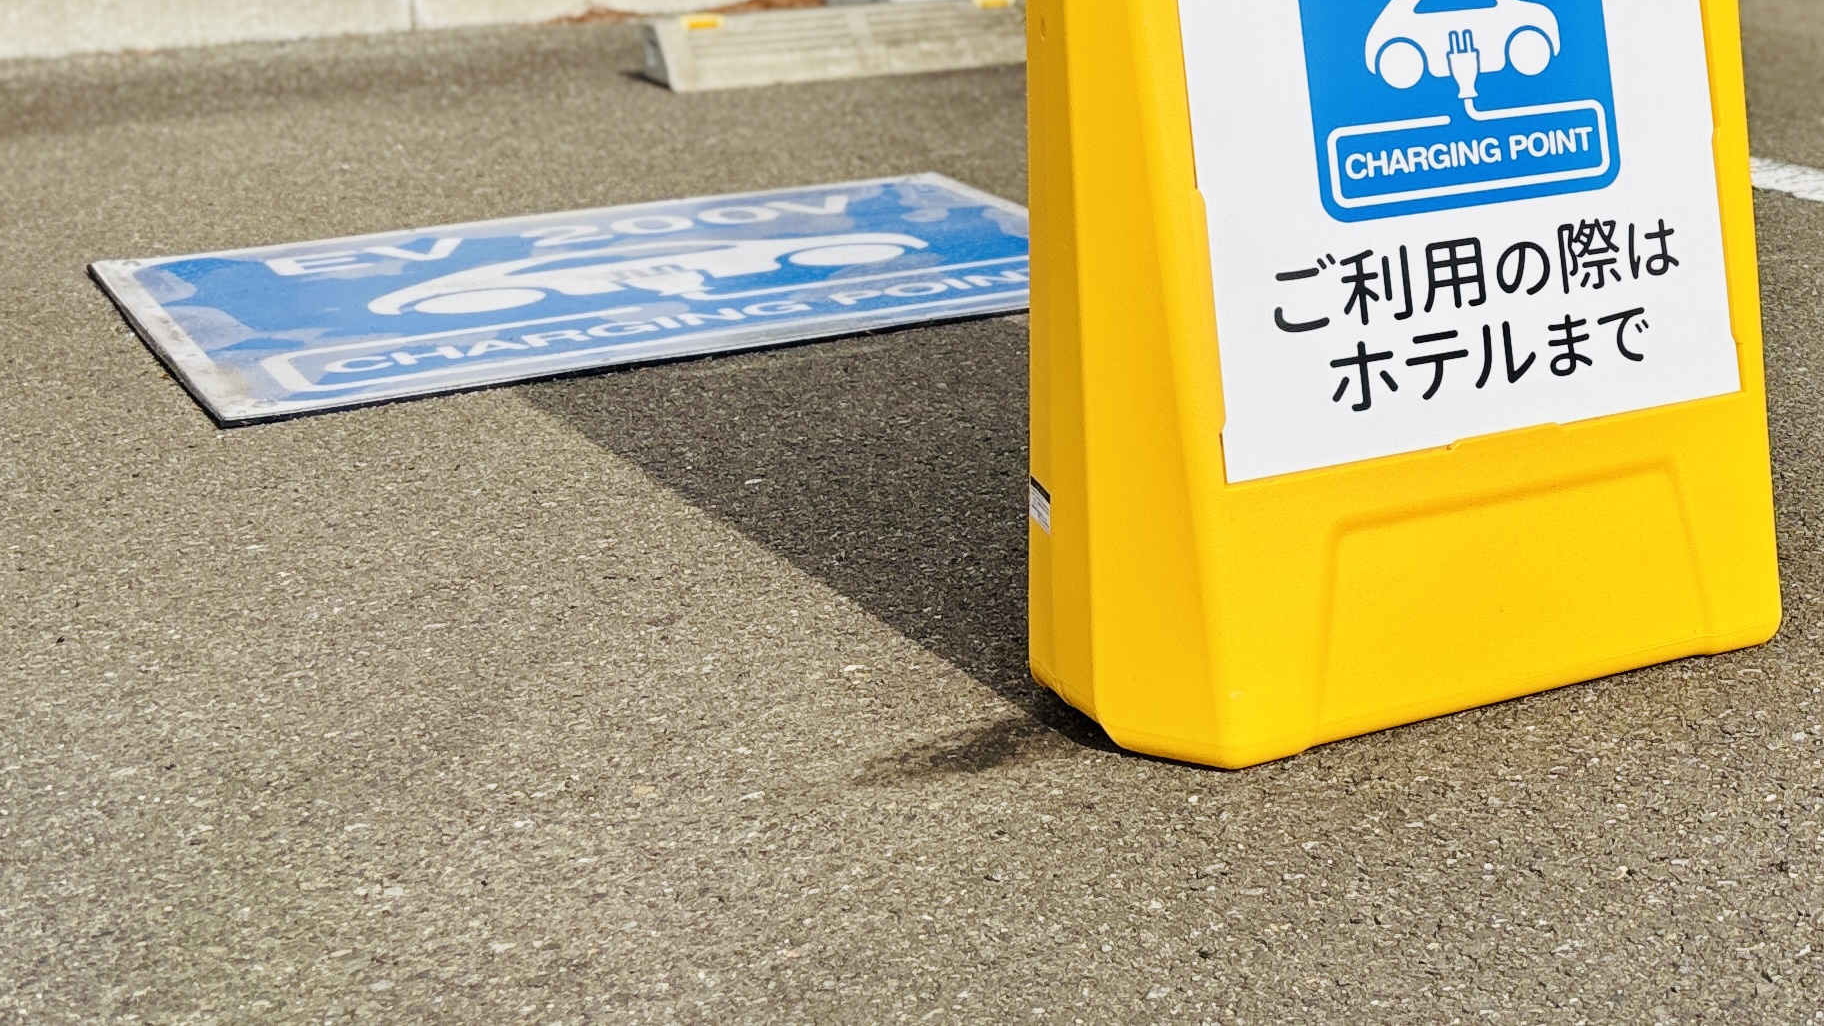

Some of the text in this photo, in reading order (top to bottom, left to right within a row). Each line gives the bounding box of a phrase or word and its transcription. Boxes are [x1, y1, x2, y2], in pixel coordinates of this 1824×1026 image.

[1345, 126, 1594, 180] CHARGING POINT
[265, 194, 848, 276] EV 200V
[1274, 218, 1680, 332] ご利用の際は
[324, 267, 1029, 373] CHARGING POIN
[1330, 307, 1650, 411] ホテルまで
